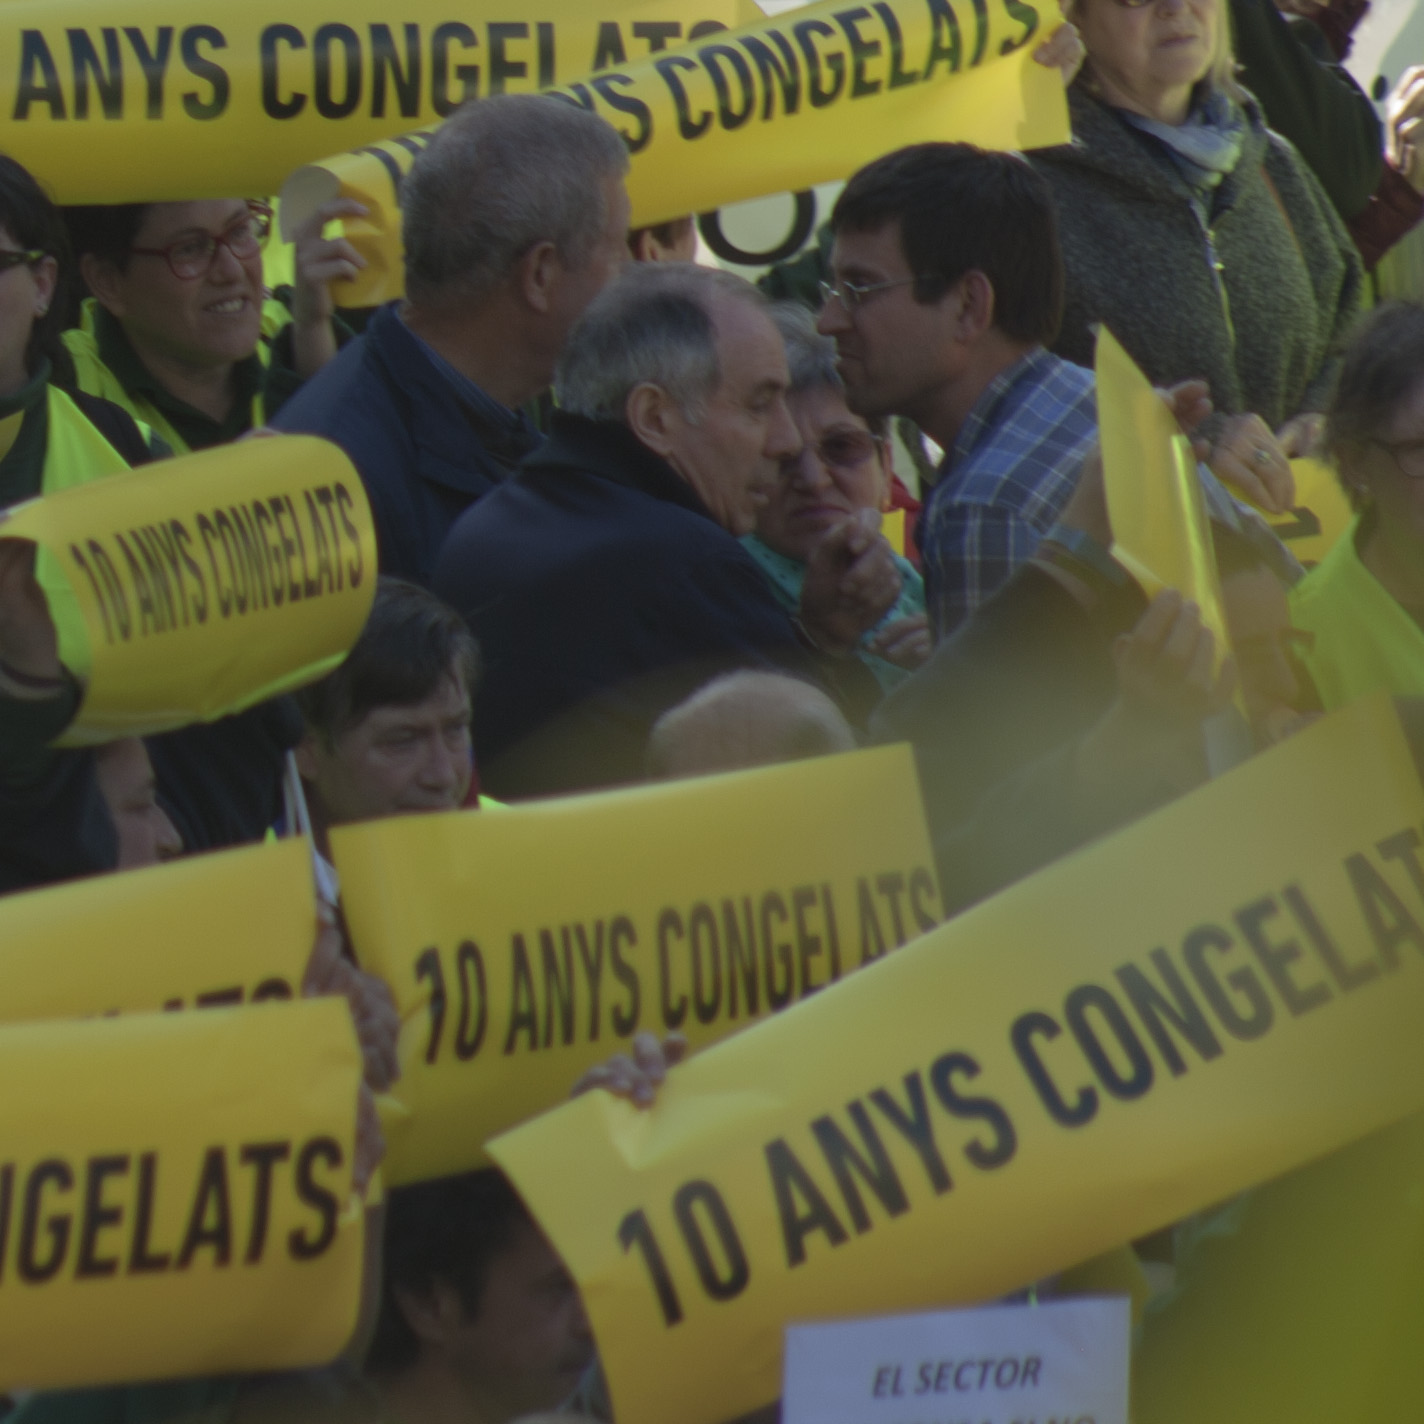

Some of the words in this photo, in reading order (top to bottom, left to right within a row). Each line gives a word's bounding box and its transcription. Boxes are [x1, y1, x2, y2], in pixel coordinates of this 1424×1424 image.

[11, 23, 231, 122] ANYS
[68, 537, 132, 646] 10
[113, 518, 210, 639] ANYS
[195, 480, 365, 621] CONGELATS
[415, 939, 486, 1066] 10
[503, 910, 643, 1058] ANYS
[616, 1178, 753, 1329] 10
[762, 1048, 1022, 1270] ANYS
[1009, 824, 1424, 1130] CONGELAT
[872, 1366, 905, 1399] EL
[913, 1354, 1044, 1396] SECTOR
